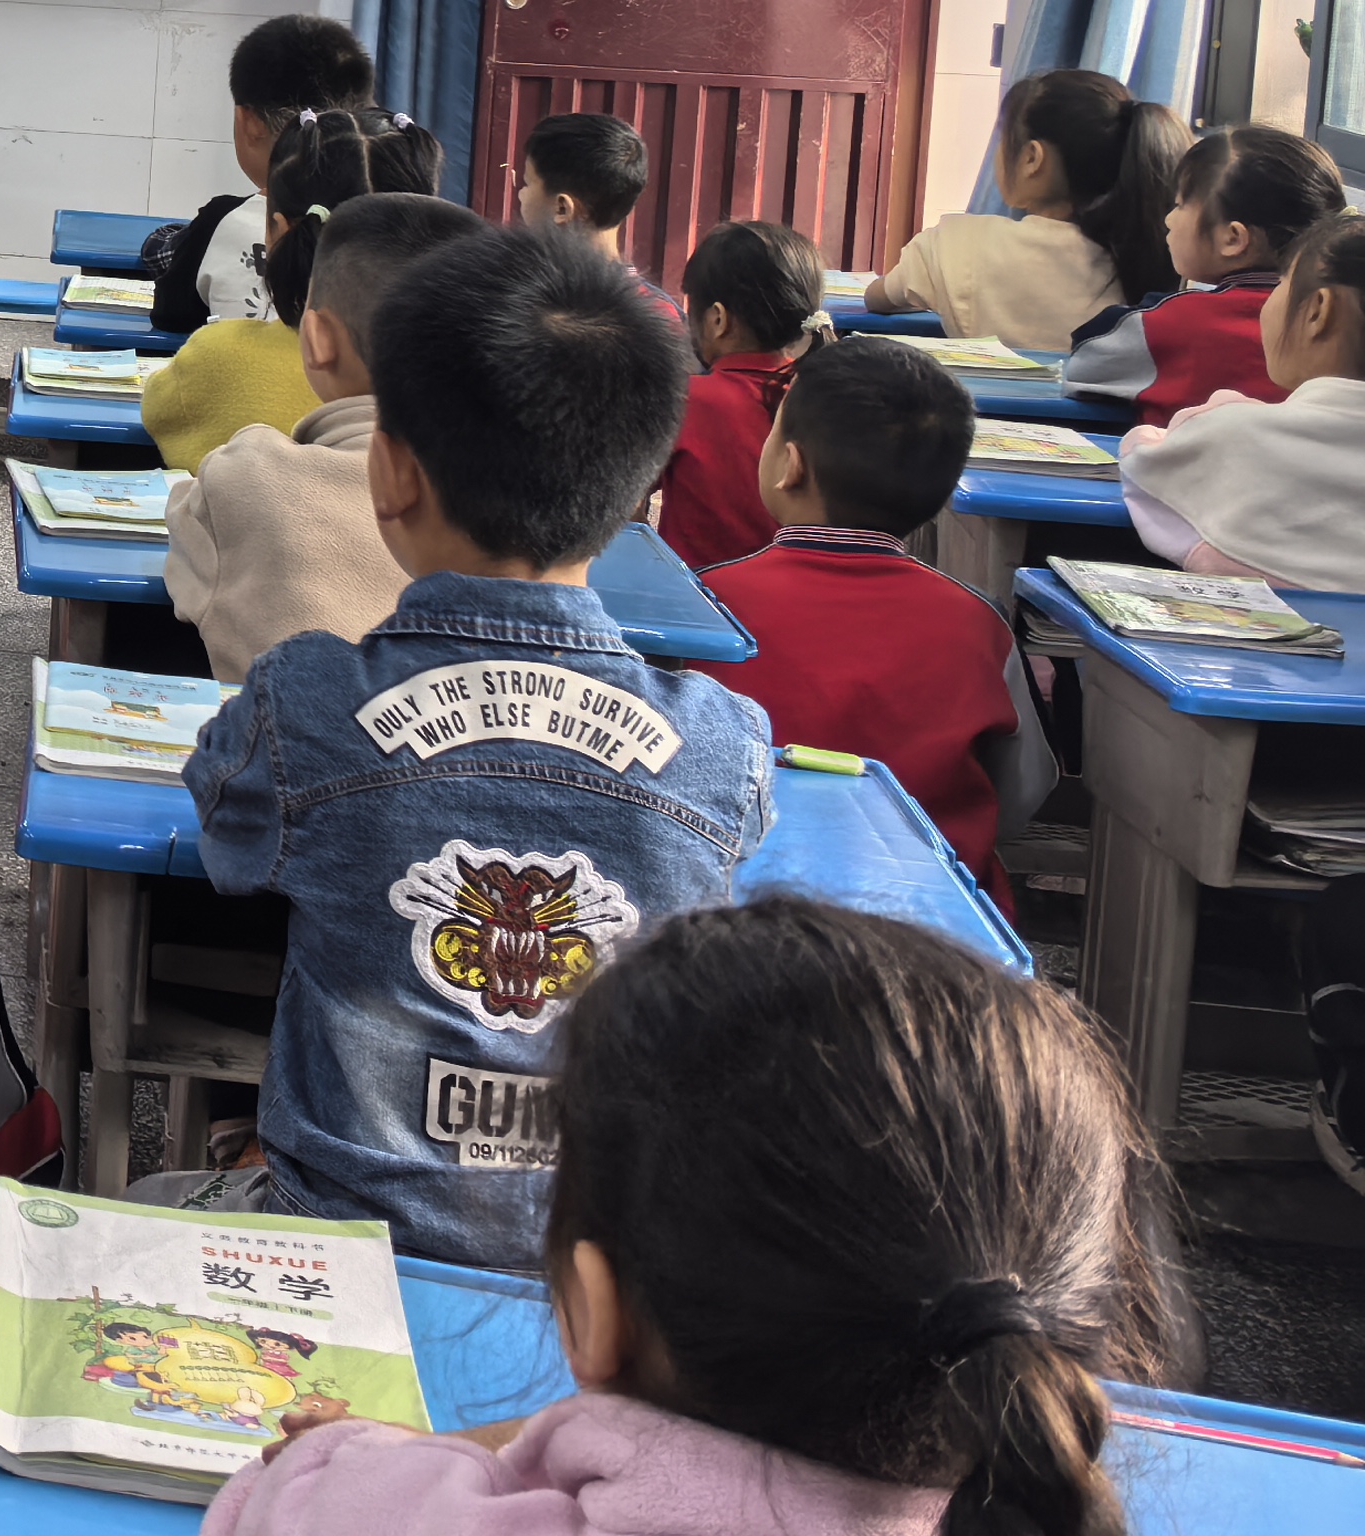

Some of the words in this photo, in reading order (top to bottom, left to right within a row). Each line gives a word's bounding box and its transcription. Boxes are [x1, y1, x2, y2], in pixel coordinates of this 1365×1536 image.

[414, 710, 467, 748] WHO
[479, 702, 531, 728] ELSE
[429, 676, 471, 706] THE
[579, 688, 665, 754] SURVIVE
[202, 1246, 328, 1272] SHUXUE
[202, 1262, 334, 1301] 数学
